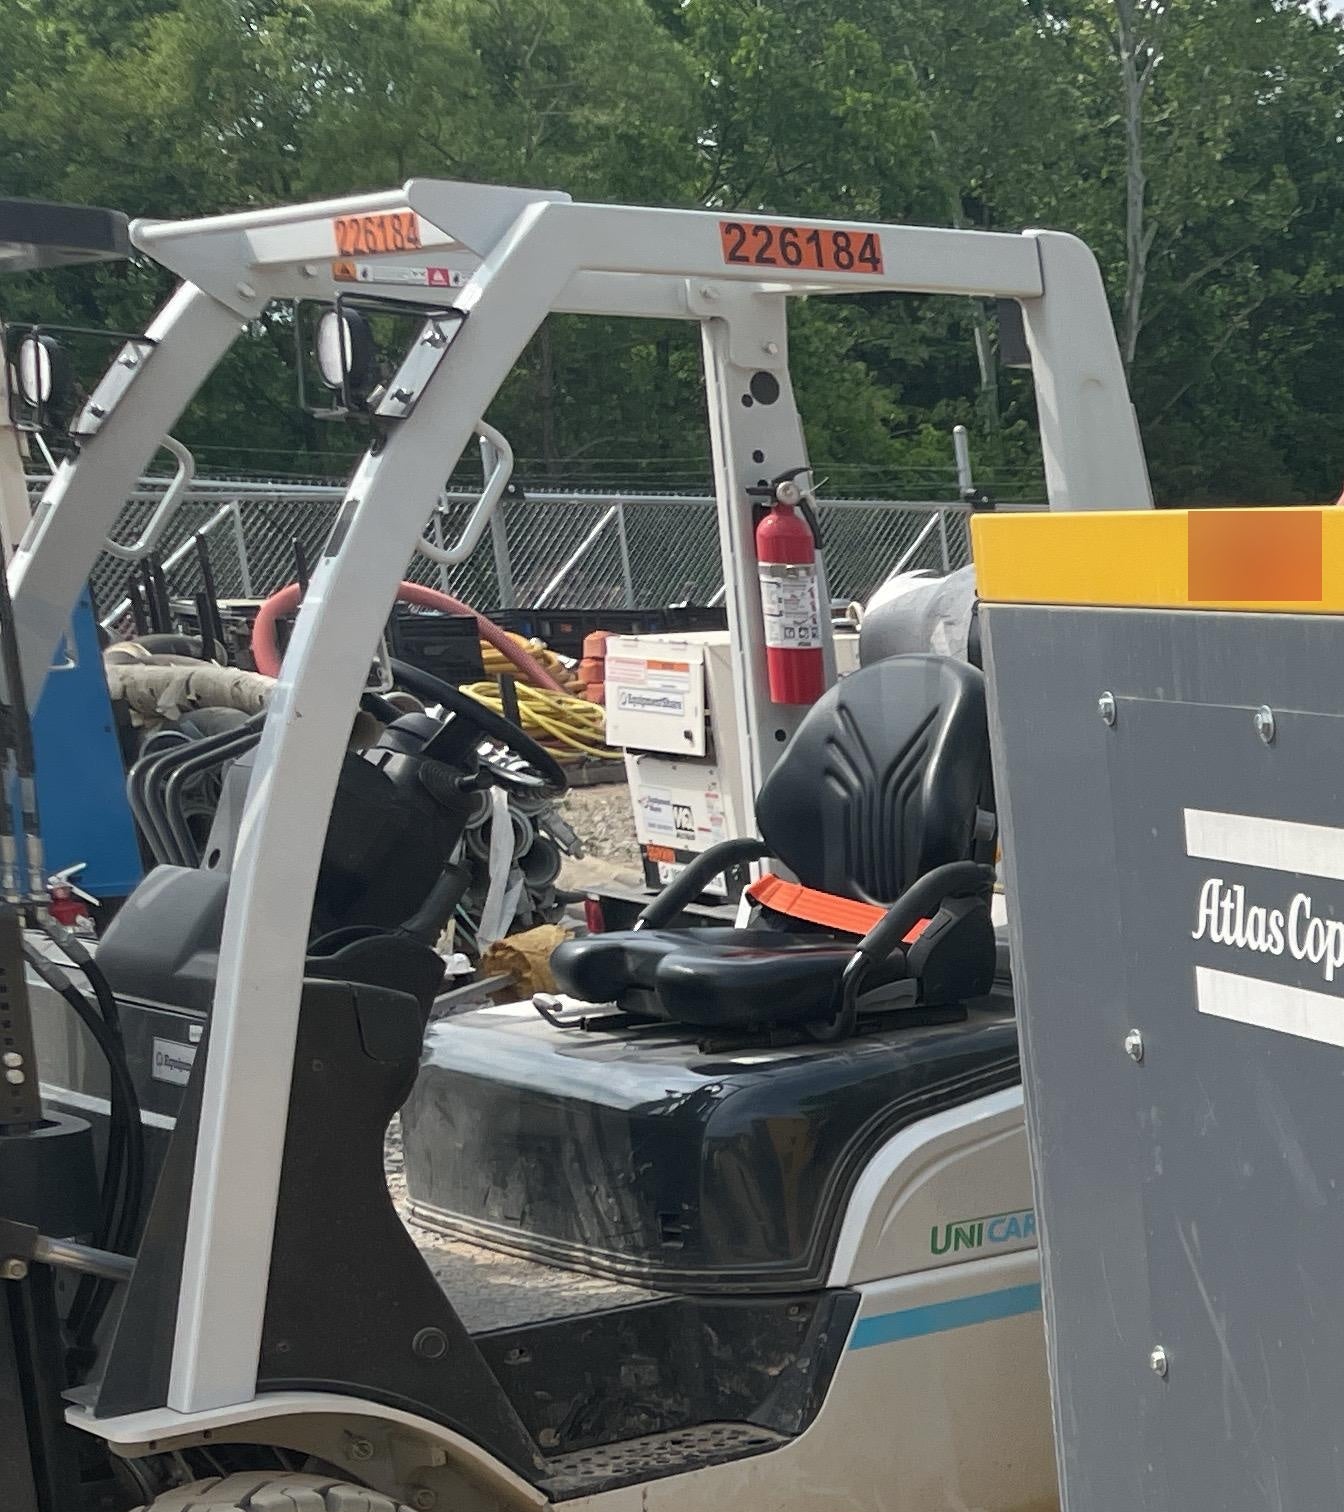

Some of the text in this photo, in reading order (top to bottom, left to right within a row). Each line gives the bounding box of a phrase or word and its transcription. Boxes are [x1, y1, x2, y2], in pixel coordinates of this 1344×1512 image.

[335, 212, 420, 256] 226184
[725, 222, 881, 272] 226184
[1192, 878, 1285, 955] Atlas
